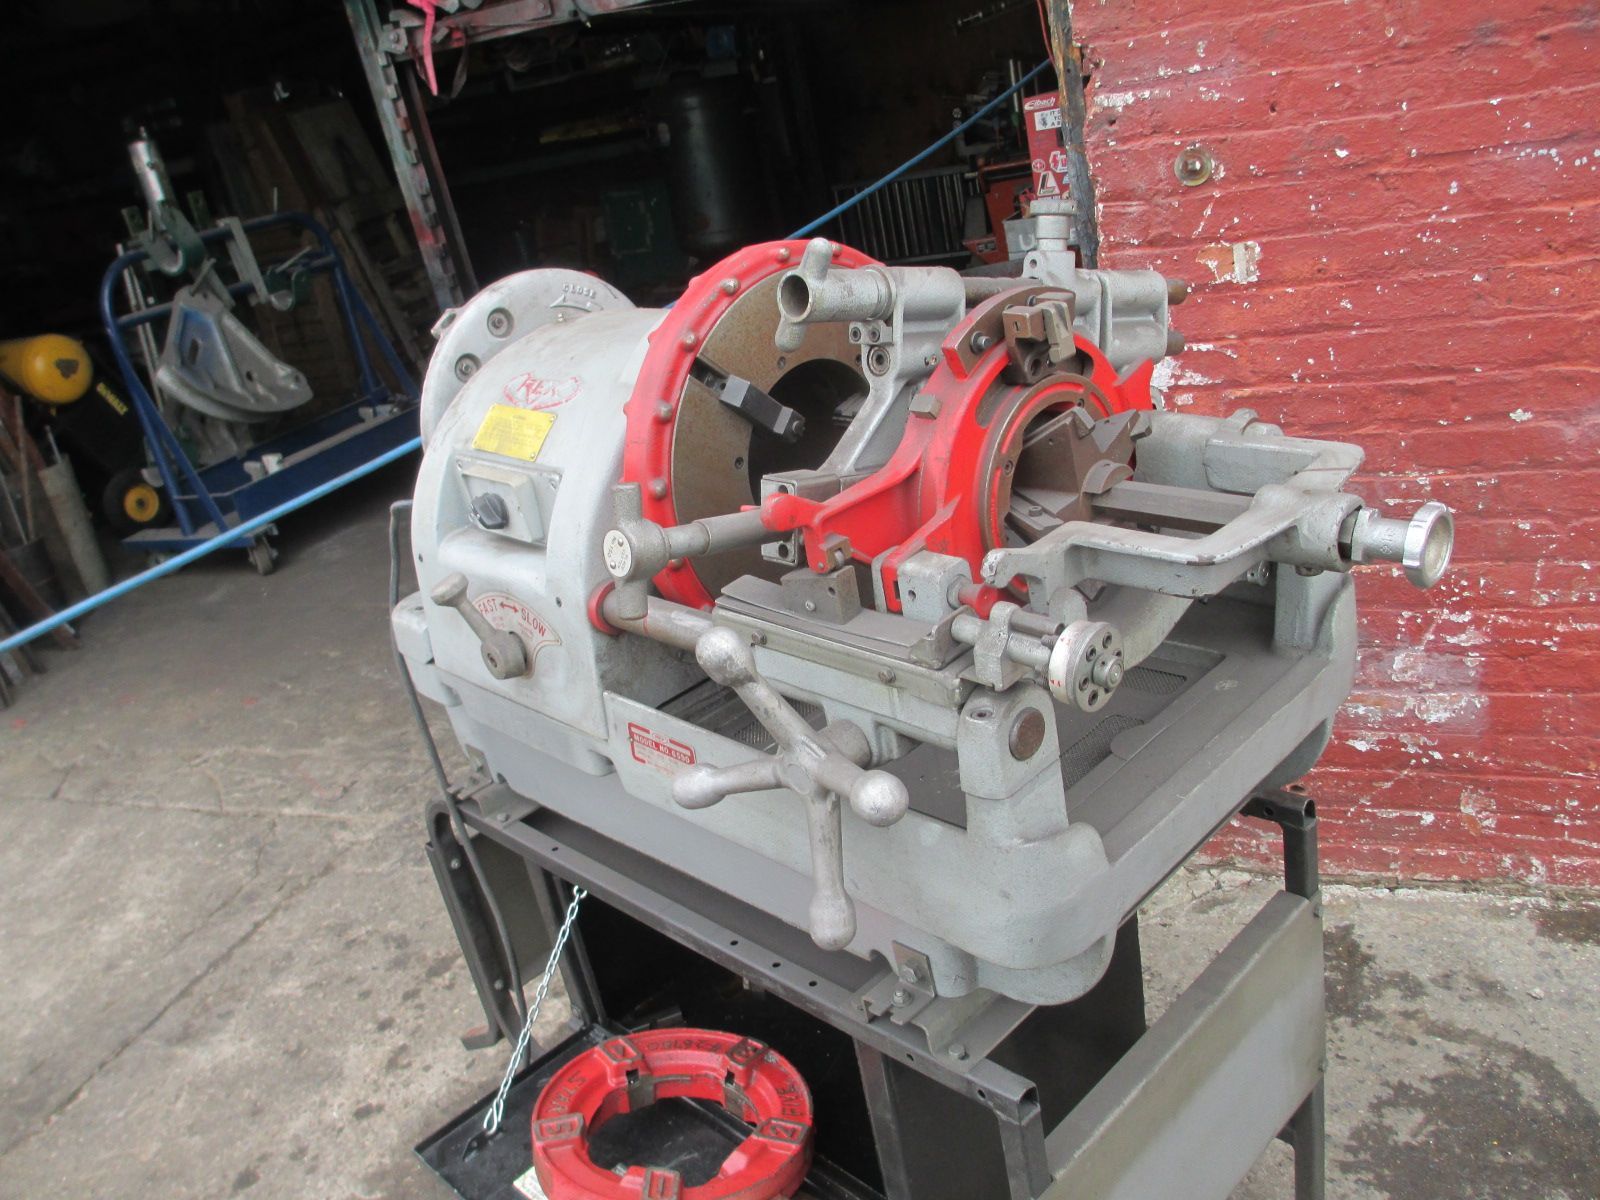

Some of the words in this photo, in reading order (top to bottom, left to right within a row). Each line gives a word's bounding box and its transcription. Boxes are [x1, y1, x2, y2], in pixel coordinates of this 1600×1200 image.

[562, 283, 597, 299] CLOSE
[477, 598, 498, 614] FAST
[521, 607, 547, 636] SLOW
[633, 734, 657, 750] MODEL
[547, 1070, 587, 1113] STAR
[770, 1125, 797, 1140] 2
